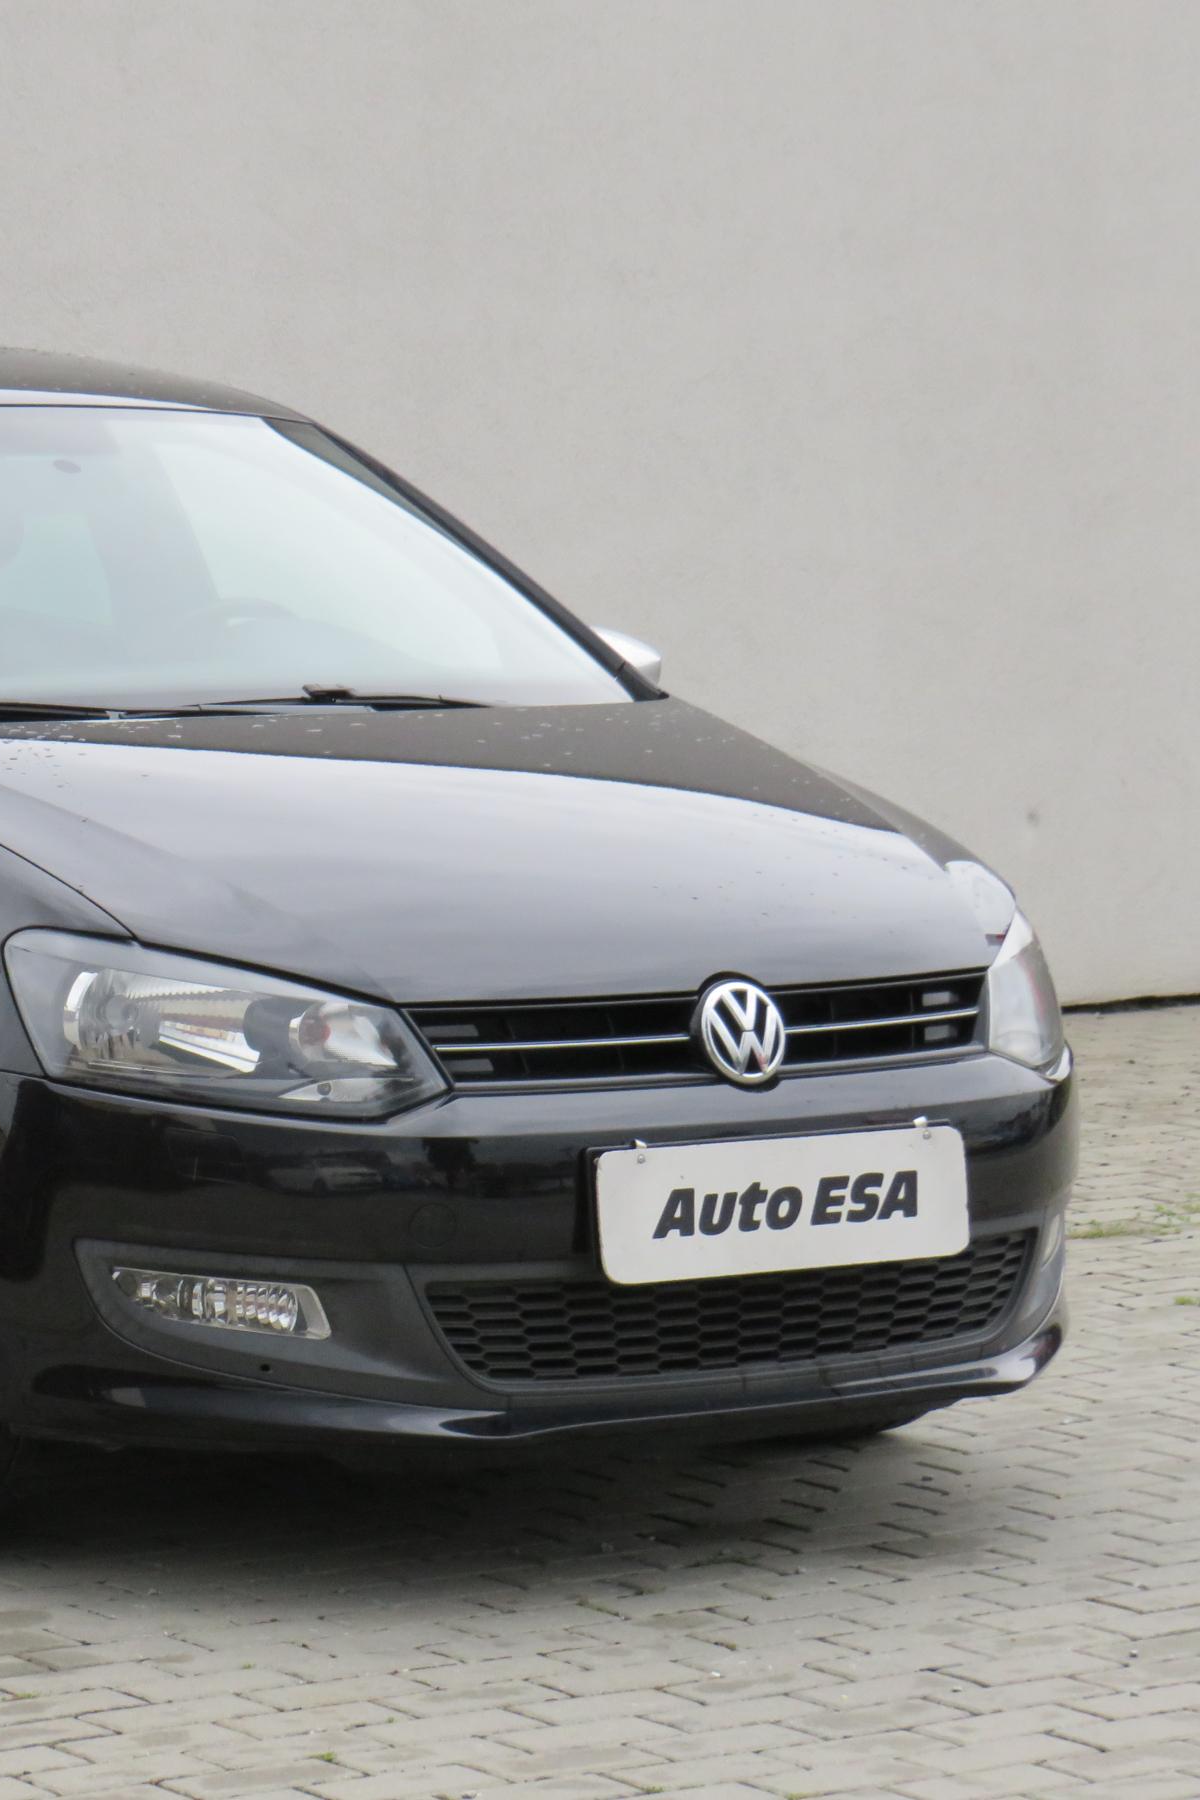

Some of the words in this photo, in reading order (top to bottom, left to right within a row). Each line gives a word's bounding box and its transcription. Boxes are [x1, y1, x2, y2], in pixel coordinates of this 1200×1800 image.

[702, 981, 785, 1084] VW
[652, 1182, 803, 1239] Auto
[810, 1170, 918, 1225] ESA
